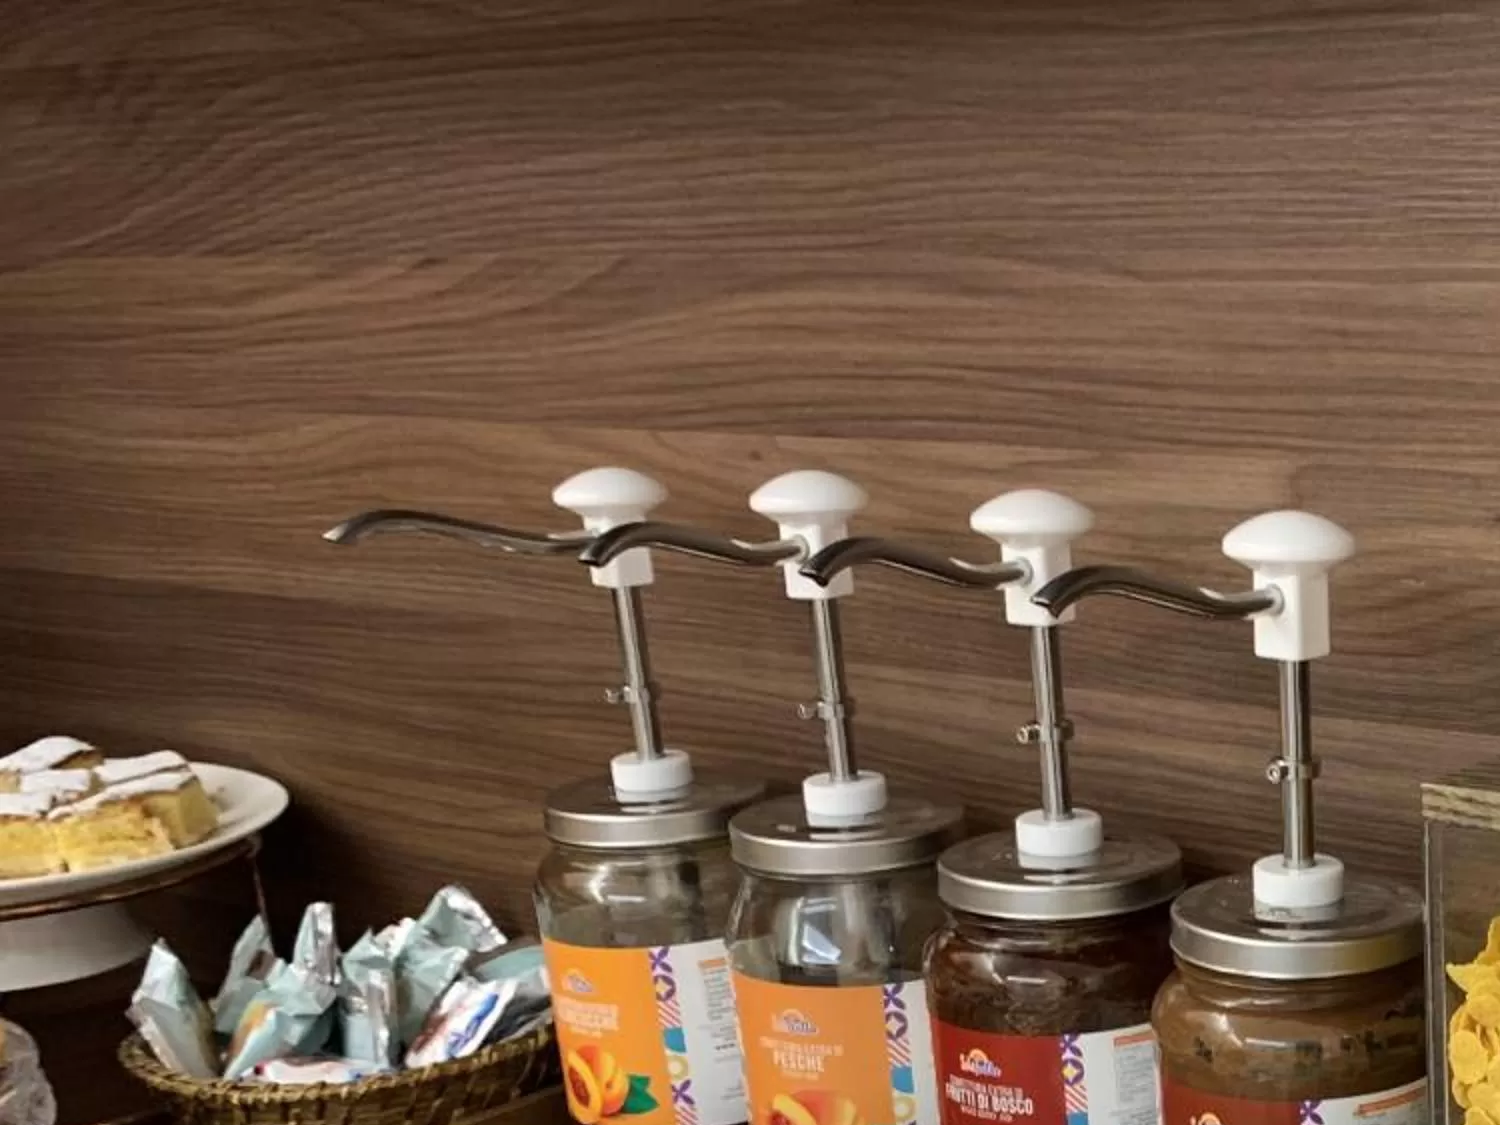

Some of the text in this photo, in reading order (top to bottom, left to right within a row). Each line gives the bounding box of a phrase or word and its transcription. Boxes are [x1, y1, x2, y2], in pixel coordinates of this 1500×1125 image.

[945, 1082, 976, 1108] FRUTTI
[977, 1093, 988, 1110] DI
[992, 1095, 1034, 1116] BOSCO
